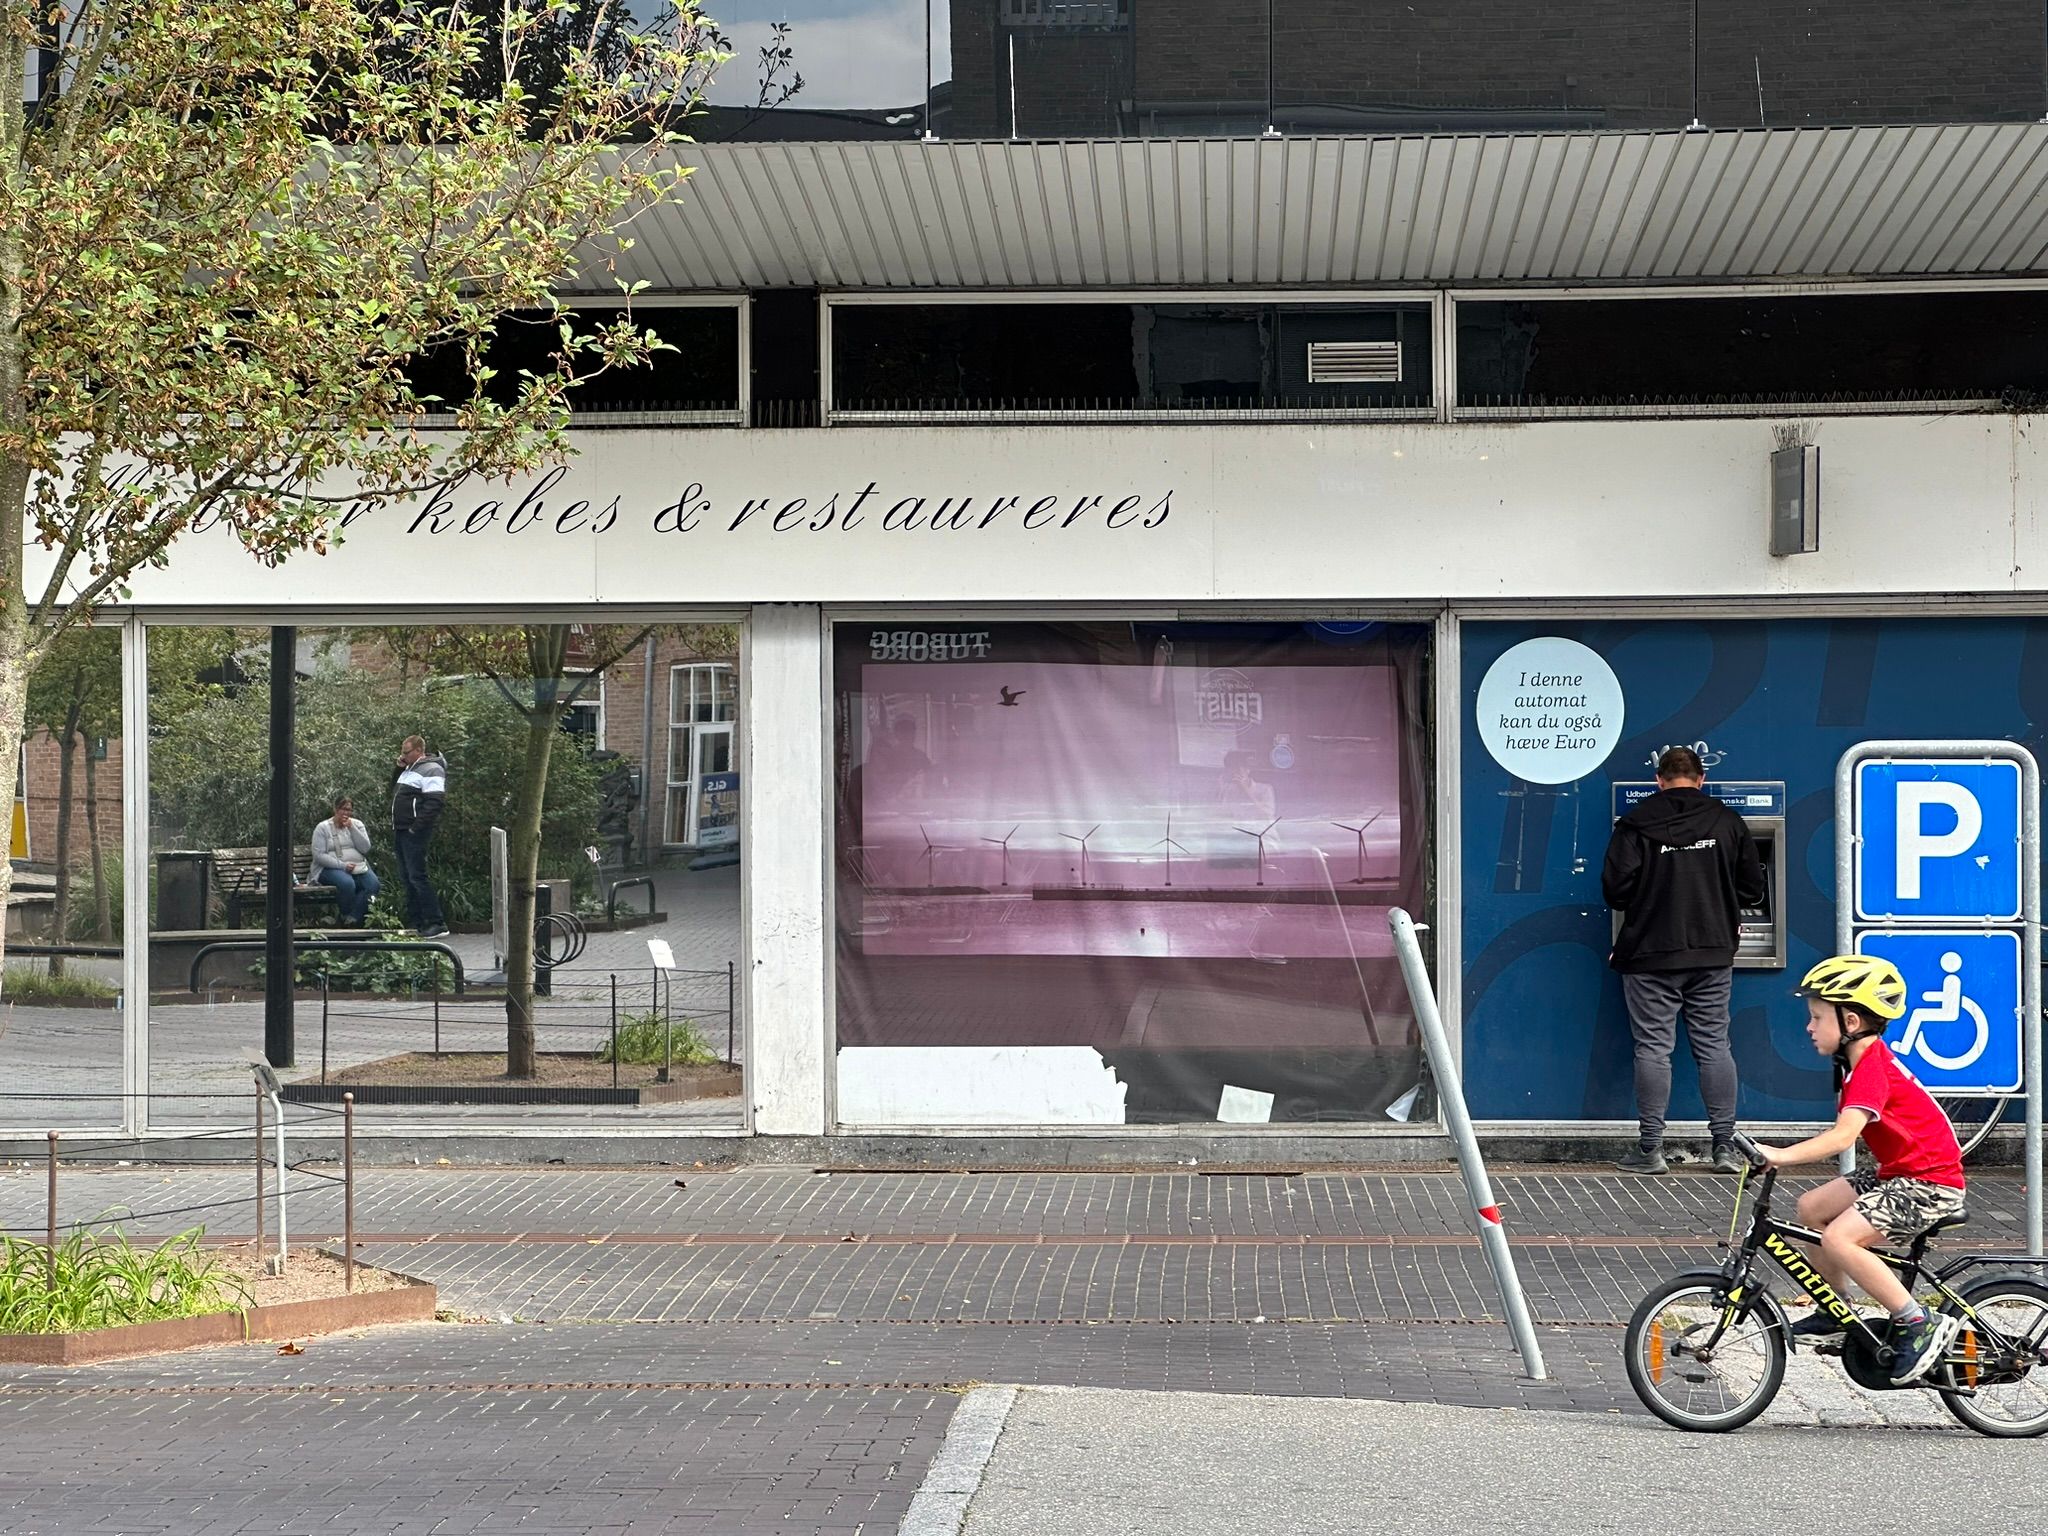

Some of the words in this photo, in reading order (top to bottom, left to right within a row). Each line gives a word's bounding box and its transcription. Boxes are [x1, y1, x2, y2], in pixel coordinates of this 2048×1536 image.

[406, 466, 621, 534] købes
[654, 482, 710, 533] &
[728, 482, 1174, 532] restaureres
[1519, 672, 1527, 687] I
[1530, 672, 1583, 687] denne
[1514, 694, 1587, 708] automat
[1499, 714, 1532, 729] kan
[1537, 714, 1559, 729] du
[1564, 713, 1602, 732] også
[1505, 735, 1550, 749] hæve
[1554, 734, 1596, 749] Euro
[1896, 781, 1982, 899] P
[1765, 1233, 1860, 1324] winther
